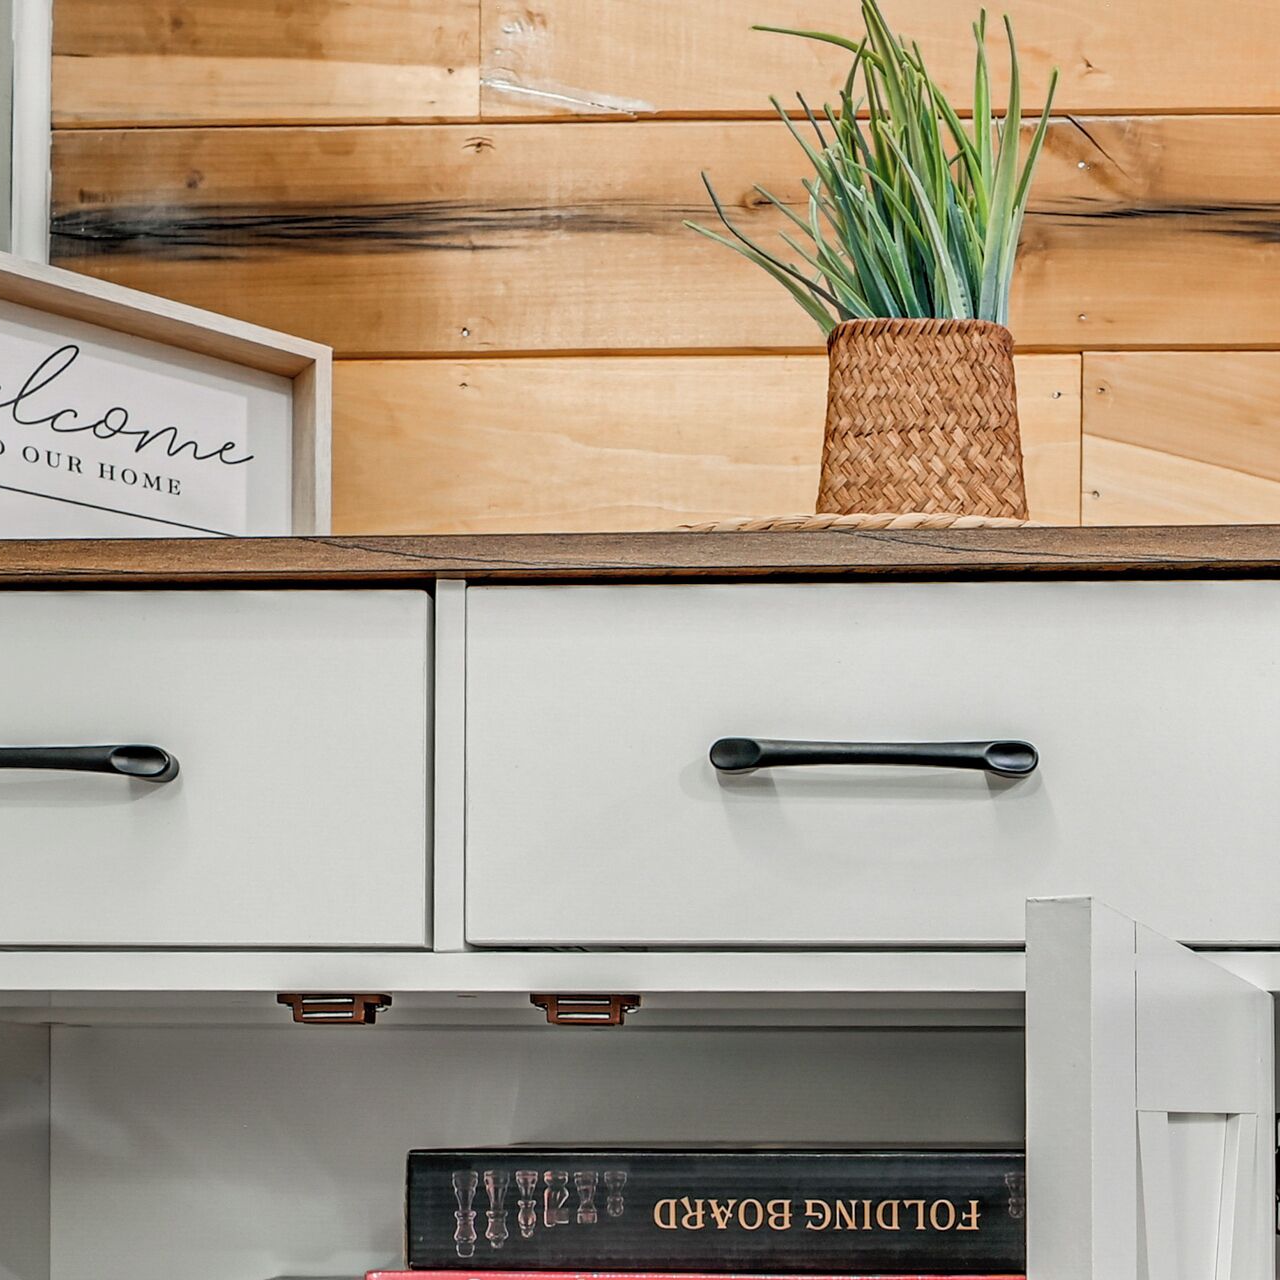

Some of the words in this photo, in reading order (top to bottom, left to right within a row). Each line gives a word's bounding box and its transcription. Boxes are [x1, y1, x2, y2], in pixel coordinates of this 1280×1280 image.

[22, 445, 83, 475] OUR
[98, 463, 183, 496] HOME
[653, 1196, 793, 1231] BOARD
[805, 1199, 981, 1231] FOLDING
